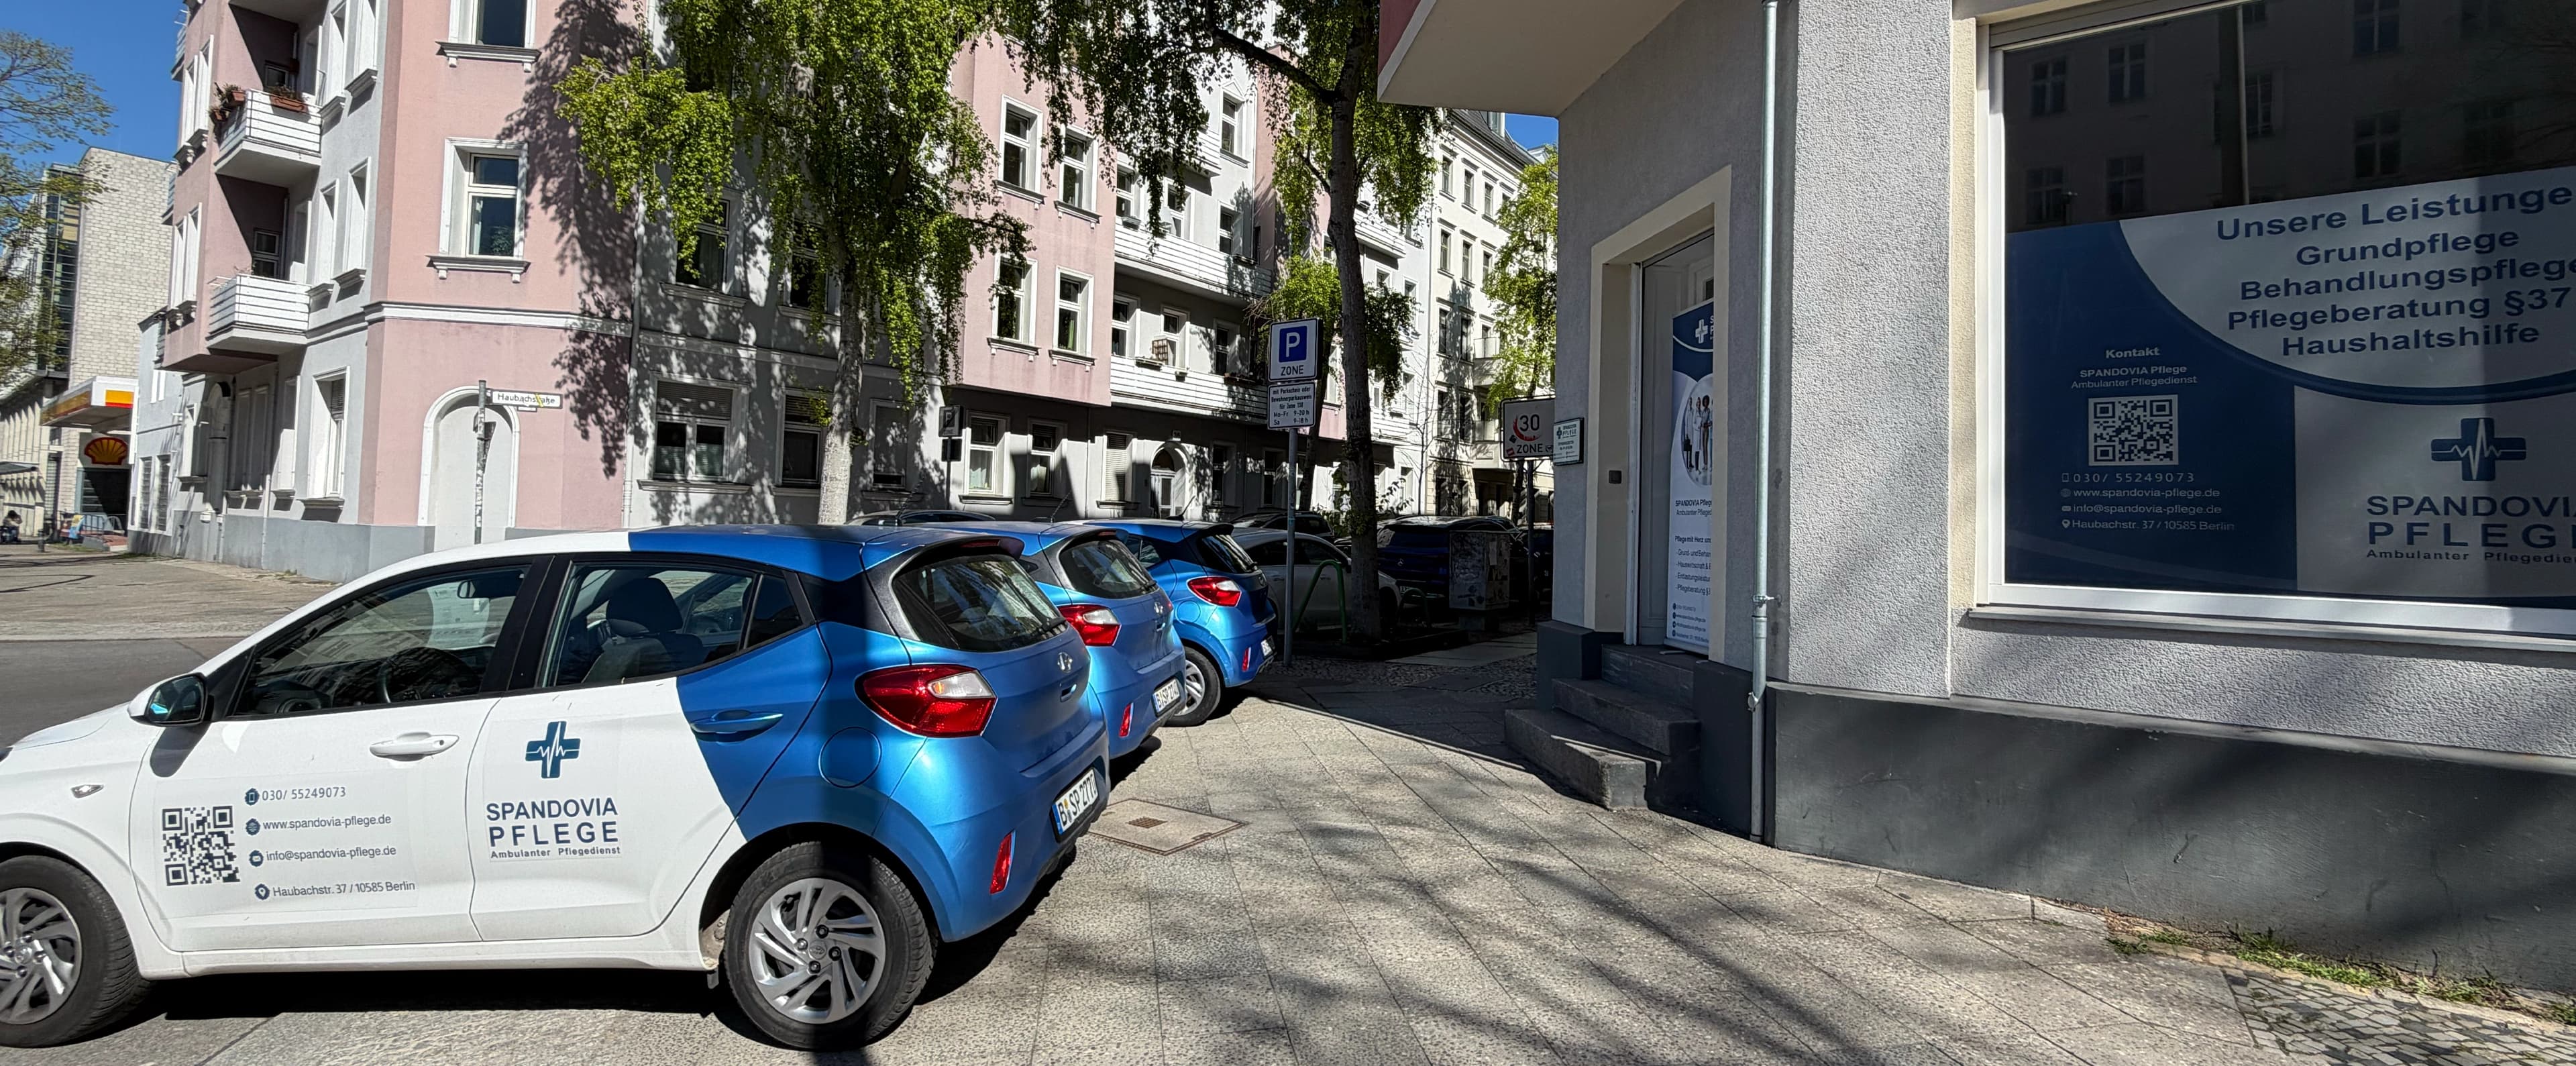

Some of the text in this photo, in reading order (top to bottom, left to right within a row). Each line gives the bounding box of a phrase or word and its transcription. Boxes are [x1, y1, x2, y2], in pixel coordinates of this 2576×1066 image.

[2217, 186, 2573, 241] Unsere Leistunge
[2296, 230, 2520, 266] Grundpflege
[2227, 286, 2571, 331] Pflegeberatung §37
[1285, 331, 1300, 358] P
[2282, 323, 2540, 357] Haushaltshilfe
[2105, 347, 2161, 359] Kontakt
[1281, 365, 1304, 376] ZONE
[2080, 365, 2188, 378] SPANDOVIA Pflege
[2072, 376, 2198, 389] Ambulanter Pflegedienst
[498, 393, 555, 405] Haubachsaße
[1519, 414, 1540, 431] 30
[1517, 443, 1543, 454] ZONE
[2074, 472, 2194, 483] 030/ 55249073
[2074, 488, 2220, 498] www.spandovia-pflege.de
[2074, 504, 2222, 515] info@spandovia-pflege.de
[2366, 495, 2576, 518] SPANDOVI
[2072, 520, 2139, 529] Haubachstr.
[2142, 520, 2155, 529] 37
[2165, 521, 2196, 530] 10585
[2199, 521, 2235, 531] Berlin
[2369, 521, 2576, 549] PFLEG
[2366, 549, 2576, 564] Ambulanter Pflegedie
[1156, 693, 1161, 708] B
[262, 786, 346, 801] 030/ 55249073
[486, 797, 618, 821] SPANDOVIA
[1058, 802, 1067, 827] B
[1069, 789, 1081, 816] SP
[263, 814, 391, 831] www.spandovia-pflege.de
[488, 820, 619, 847] PFLEGE
[266, 845, 397, 862] info@spandovia-pflege.de
[490, 846, 621, 859] Ambulanter Pflegedienst
[272, 880, 416, 898] Haubachstr. 37 / 10585 Berlin
